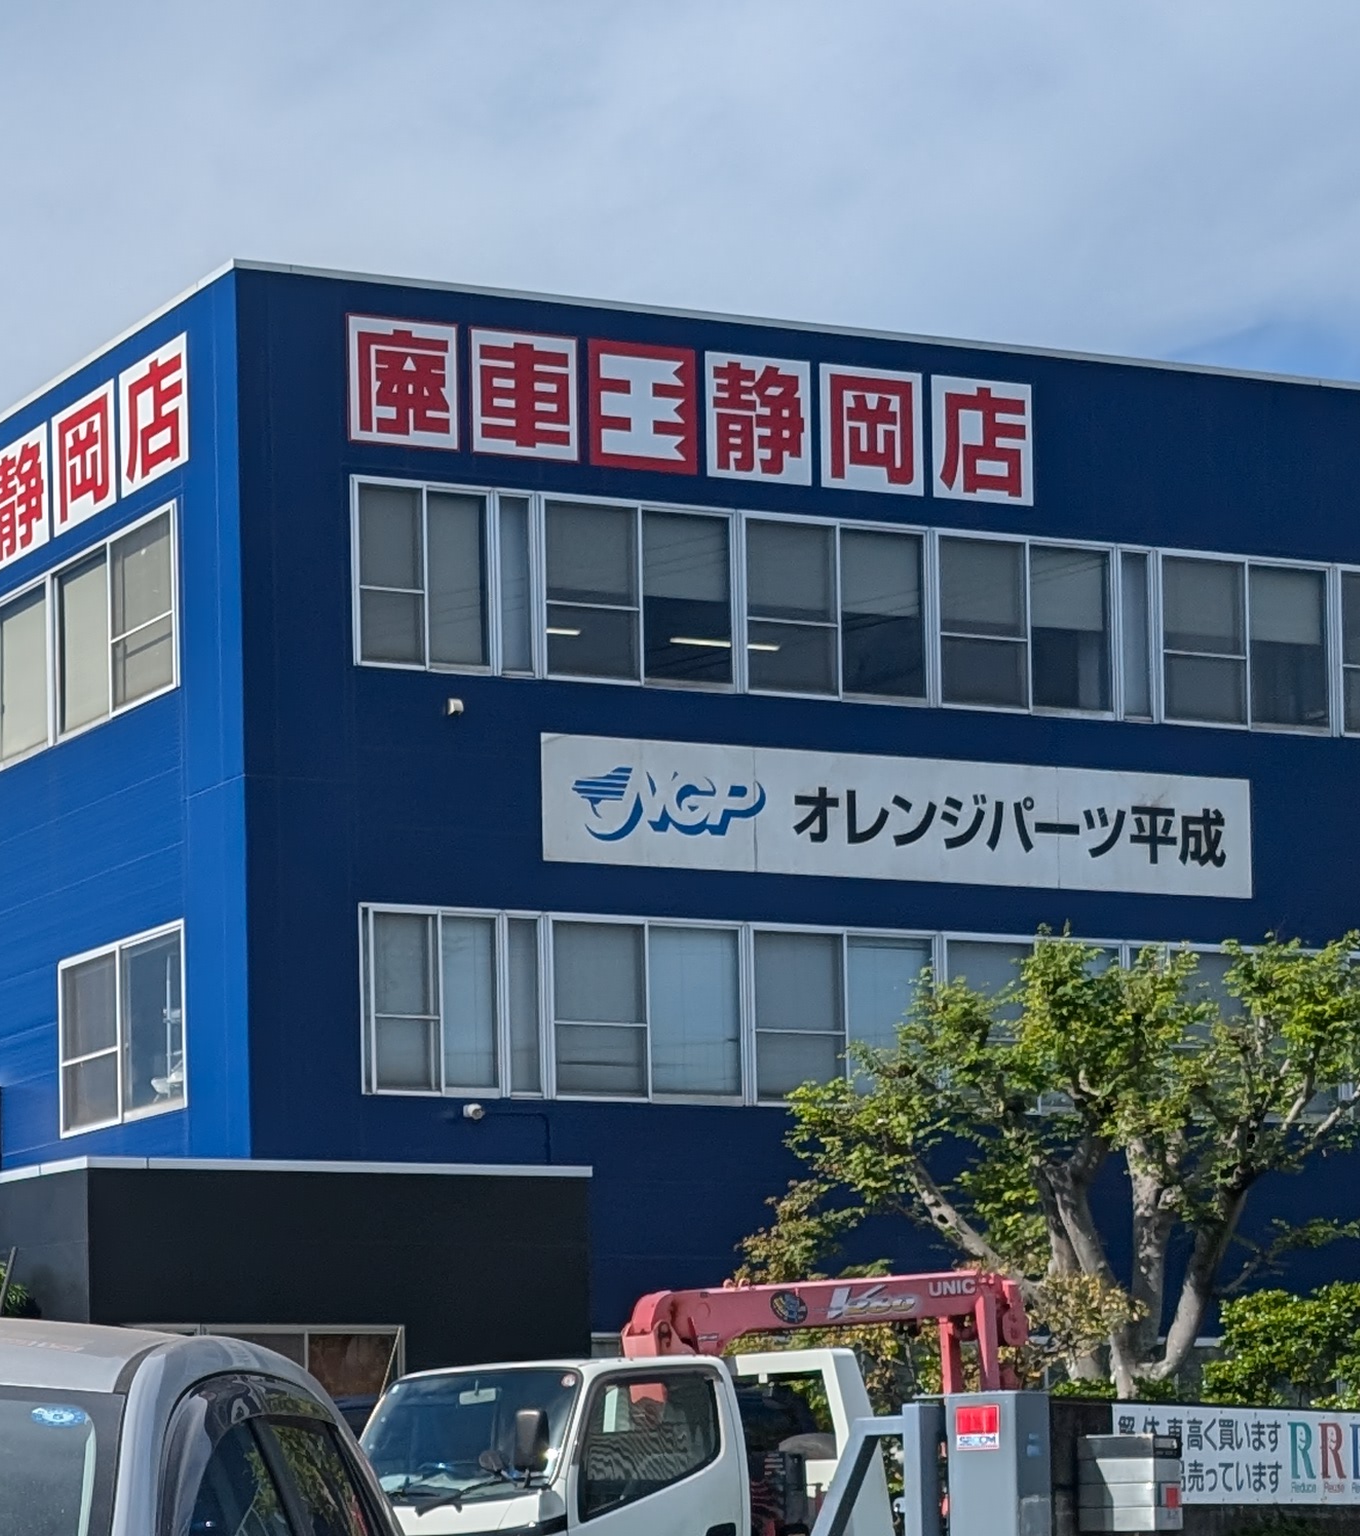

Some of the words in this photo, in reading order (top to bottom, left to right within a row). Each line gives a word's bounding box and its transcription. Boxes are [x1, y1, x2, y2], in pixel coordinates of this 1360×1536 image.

[353, 324, 1025, 500] 廃車王静岡店
[793, 785, 1226, 869] オレンジパーツ平成
[929, 1279, 977, 1297] UNIC
[1291, 1481, 1317, 1494] Reduce
[1323, 1482, 1346, 1494] Reuse
